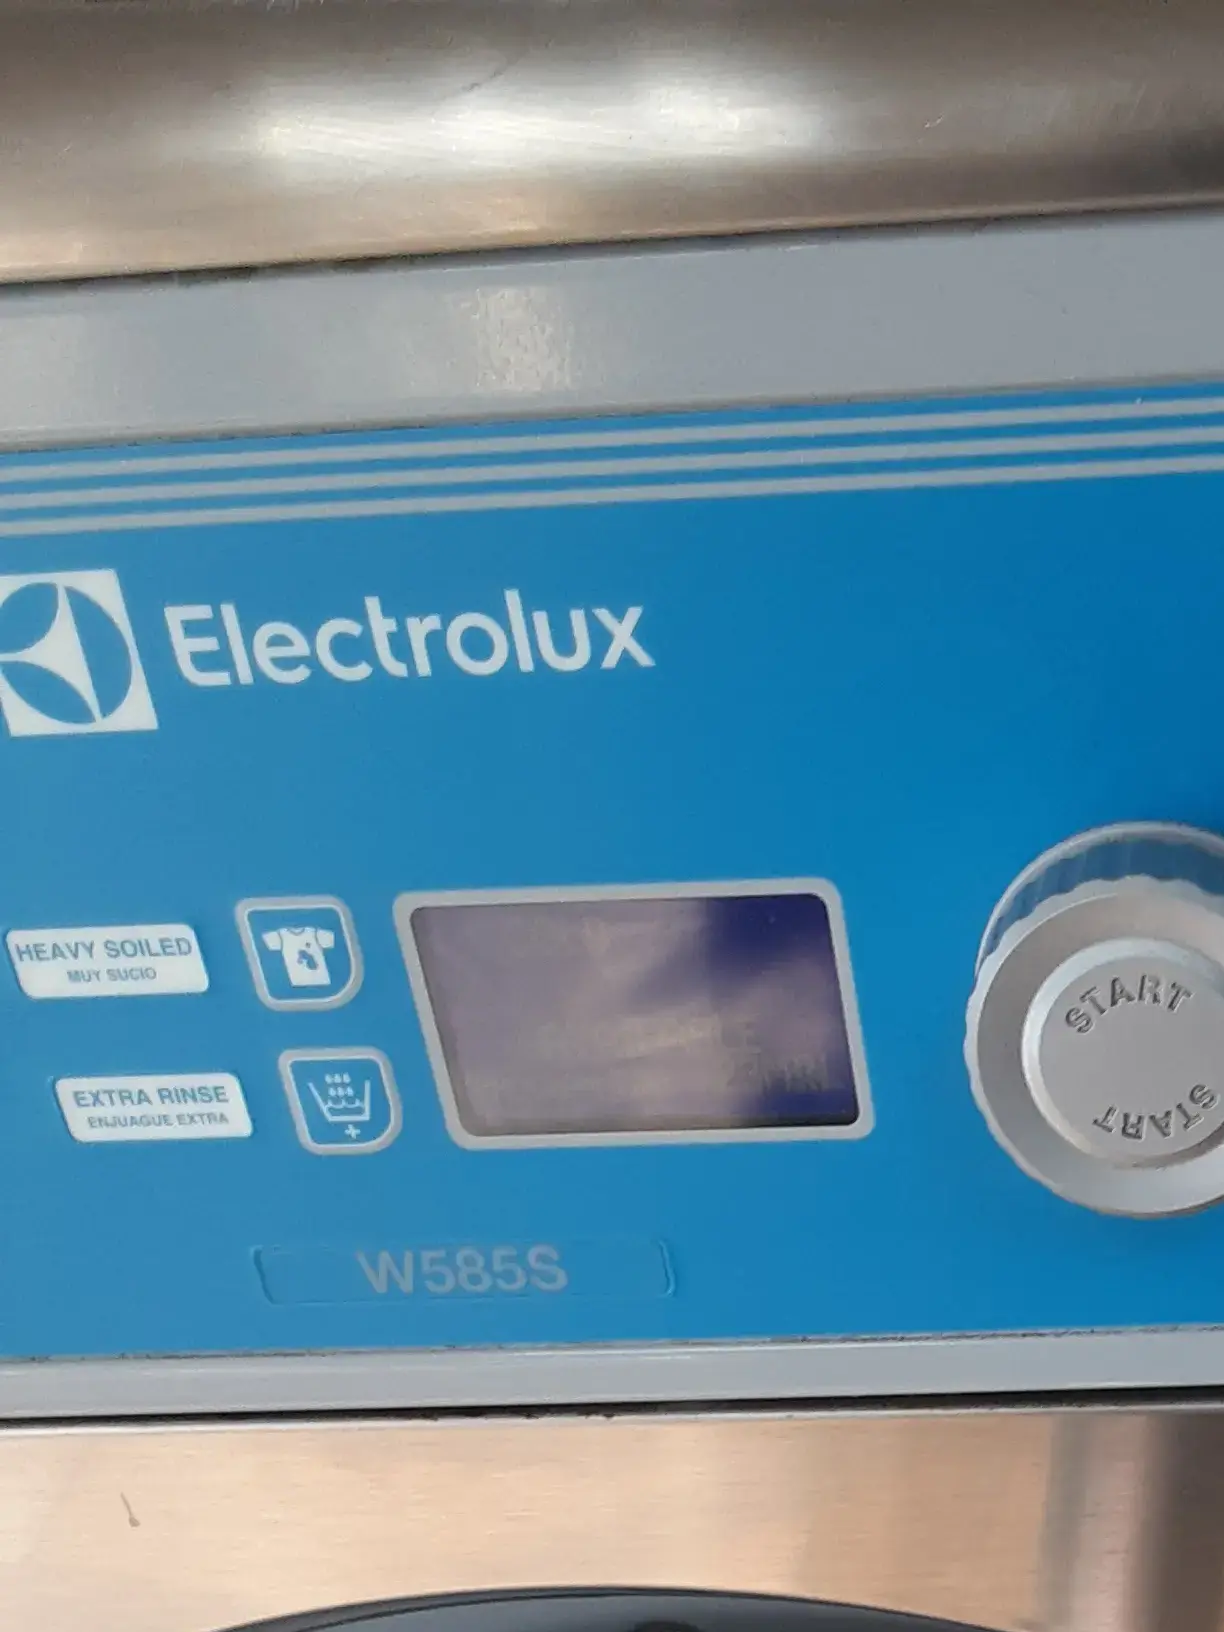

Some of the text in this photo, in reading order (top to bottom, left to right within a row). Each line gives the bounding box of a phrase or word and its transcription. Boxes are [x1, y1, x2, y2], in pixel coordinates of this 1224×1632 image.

[164, 588, 656, 687] Electrolux
[14, 937, 193, 963] HEAVY SOILED
[66, 967, 157, 983] MUY SUCIO
[1065, 973, 1193, 1035] START
[72, 1085, 230, 1108] EXTRA RINSE
[1091, 1083, 1219, 1141] START
[87, 1111, 229, 1129] ENJUAGUE EXTRA
[356, 1245, 569, 1296] W585S
